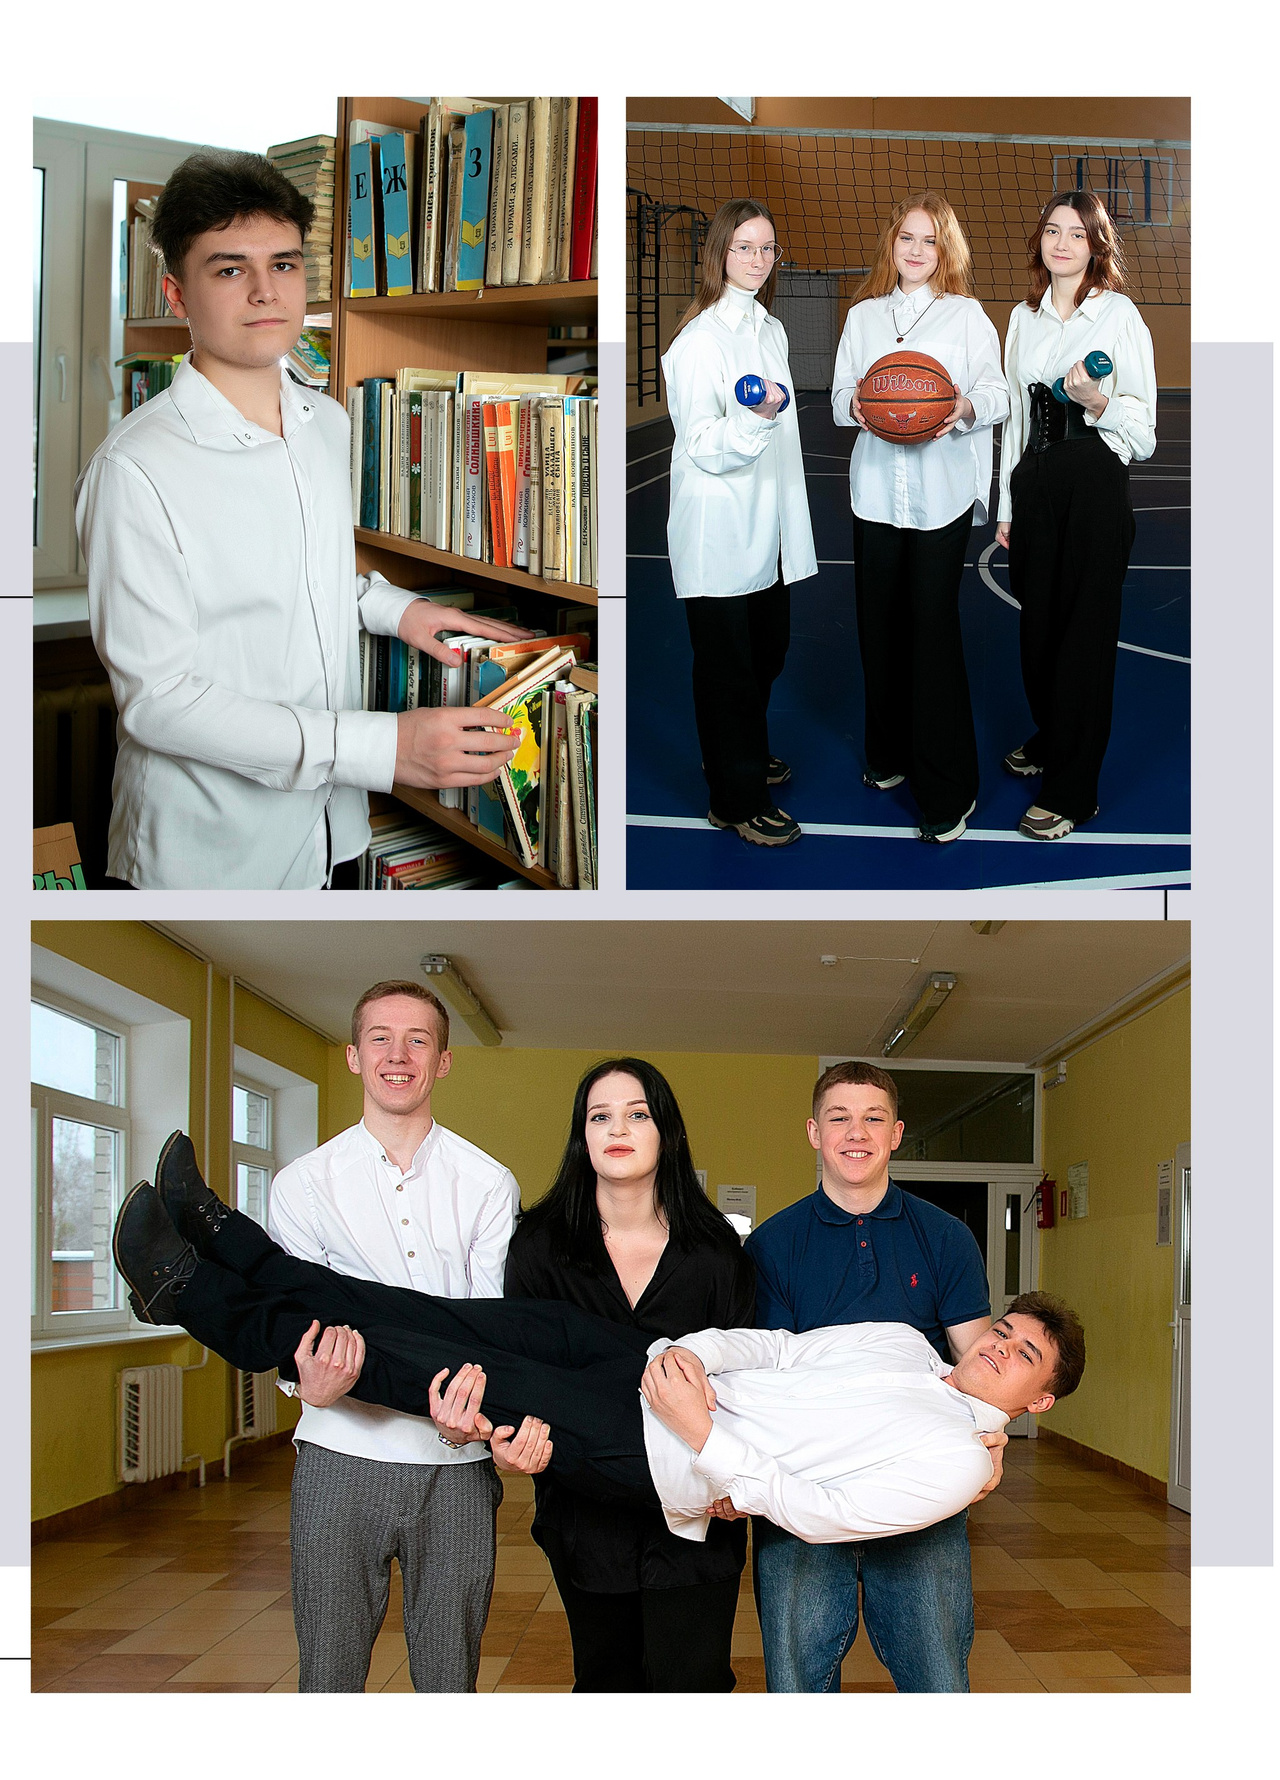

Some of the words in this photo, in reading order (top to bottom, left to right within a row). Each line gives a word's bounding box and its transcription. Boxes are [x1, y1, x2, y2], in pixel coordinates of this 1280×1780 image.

[354, 172, 368, 201] Е
[383, 164, 407, 196] Ж
[493, 186, 499, 197] ЗА
[527, 180, 533, 192] ЗА
[507, 238, 513, 249] ЗА
[510, 182, 516, 194] ЗА
[491, 240, 497, 252] ЗА
[525, 239, 531, 249] ЗА
[872, 373, 937, 394] Wilson
[470, 401, 480, 475] Солнышкина
[518, 408, 526, 467] ПРИКЛЮЧЕНИЯ
